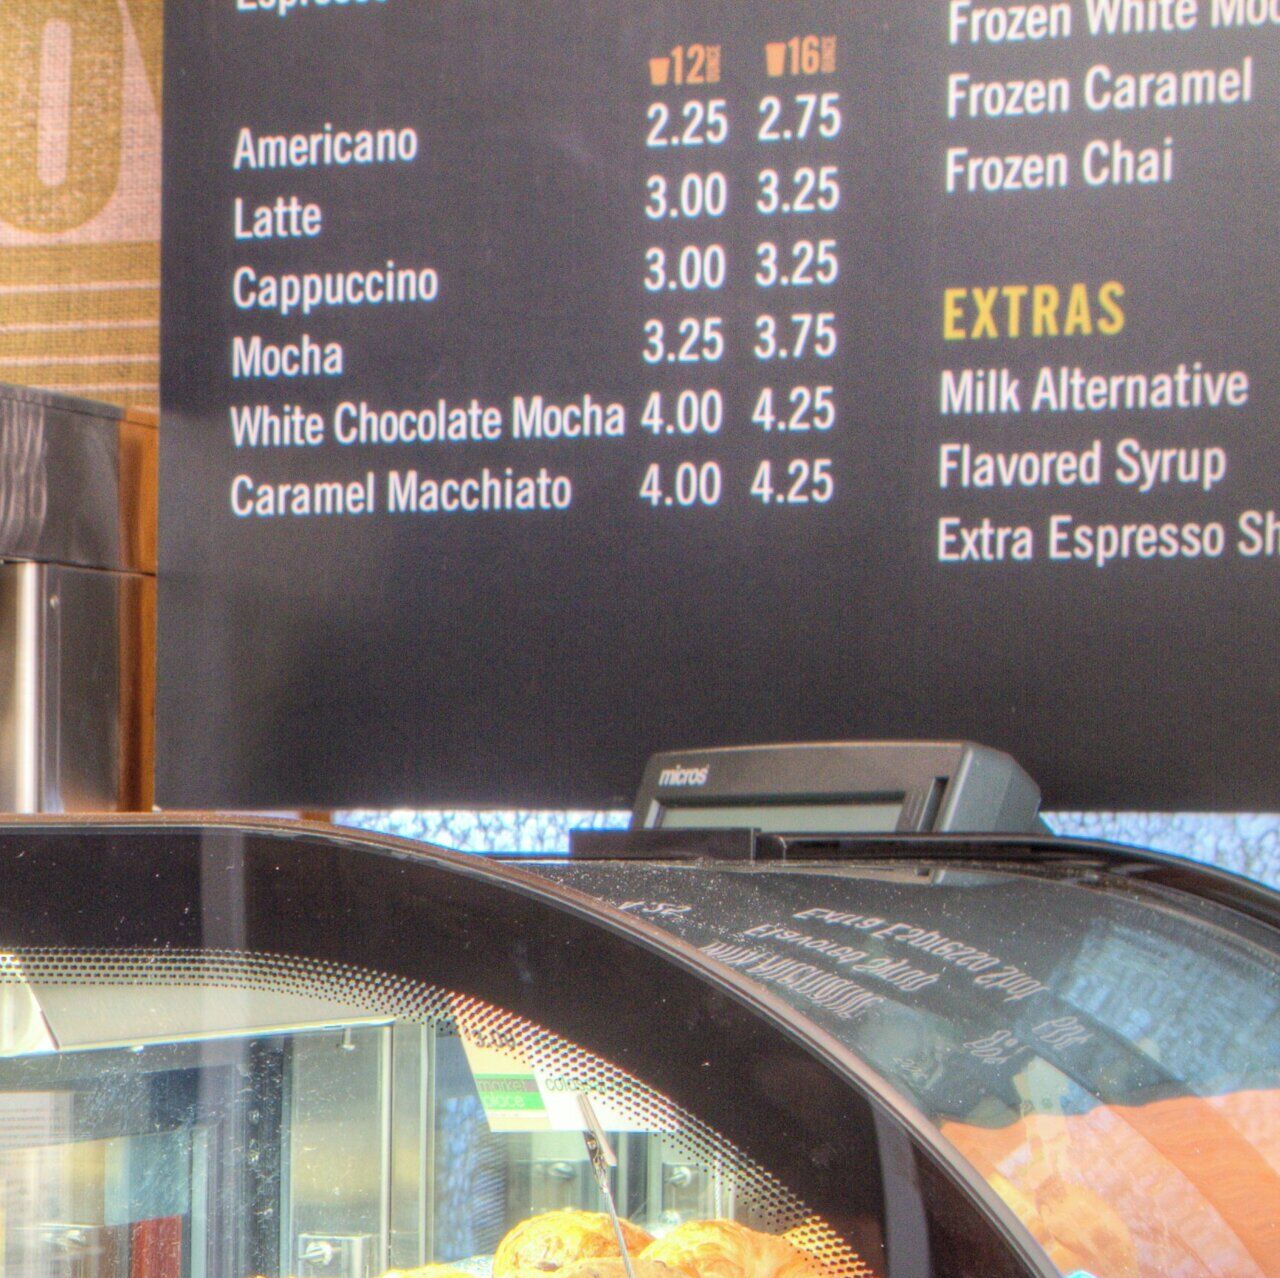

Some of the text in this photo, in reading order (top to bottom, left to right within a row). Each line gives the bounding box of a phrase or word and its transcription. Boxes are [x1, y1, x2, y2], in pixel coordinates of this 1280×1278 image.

[949, 0, 1071, 44] Frozen
[1085, 0, 1198, 36] White
[671, 43, 705, 85] 12
[787, 34, 819, 75] 16
[947, 55, 1253, 118] Frozen Caramel
[234, 93, 841, 170] Americano 2.25 2.75
[945, 136, 1174, 192] Frozen Chai
[234, 166, 840, 240] Latte 3.00 3.25
[233, 239, 839, 314] Cappuccino 3.00 3.25
[943, 280, 1126, 341] EXTRAS
[231, 312, 838, 378] Mocha 3.25 3.75
[230, 386, 835, 447] White Chocolate Mocha 4.00 4.25
[940, 361, 1249, 415] Milk Alternative
[231, 458, 834, 517] Caramel Macchiato 4.00 4.25
[938, 437, 1227, 492] Flavored Syrup
[937, 516, 1034, 562] Extra
[1048, 513, 1225, 566] Espresso
[658, 764, 709, 787] micros
